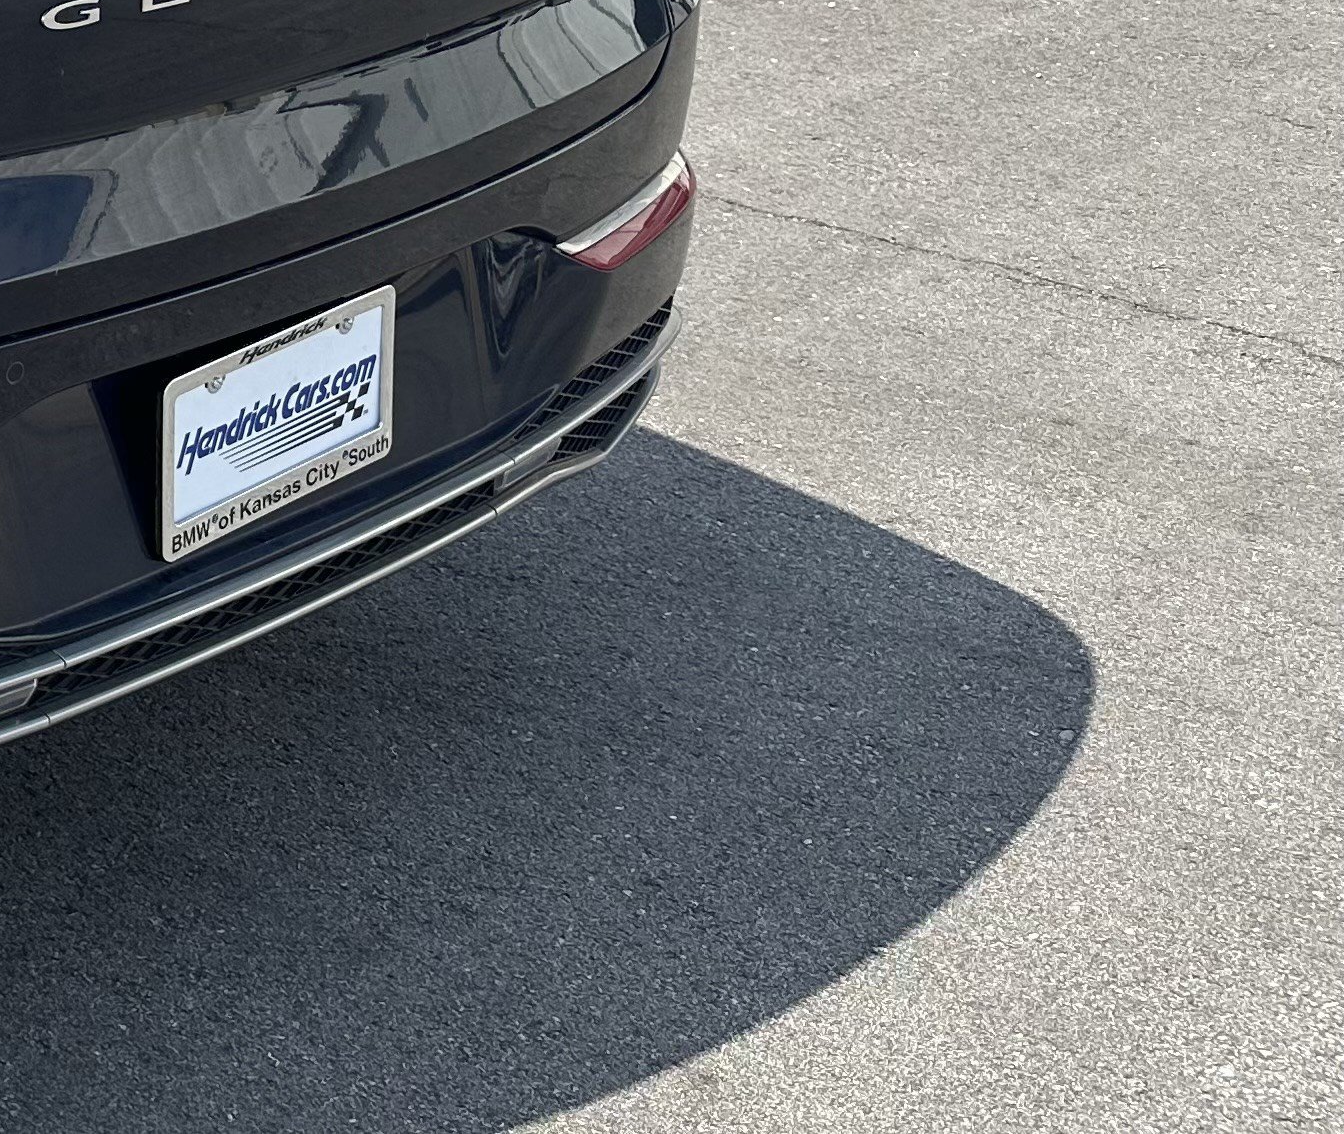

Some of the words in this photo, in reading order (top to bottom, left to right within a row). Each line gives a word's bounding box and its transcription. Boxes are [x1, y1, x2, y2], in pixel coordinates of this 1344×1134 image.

[218, 509, 236, 530] of
[239, 479, 301, 520] Kansas
[305, 461, 340, 487] City
[348, 435, 390, 467] South
